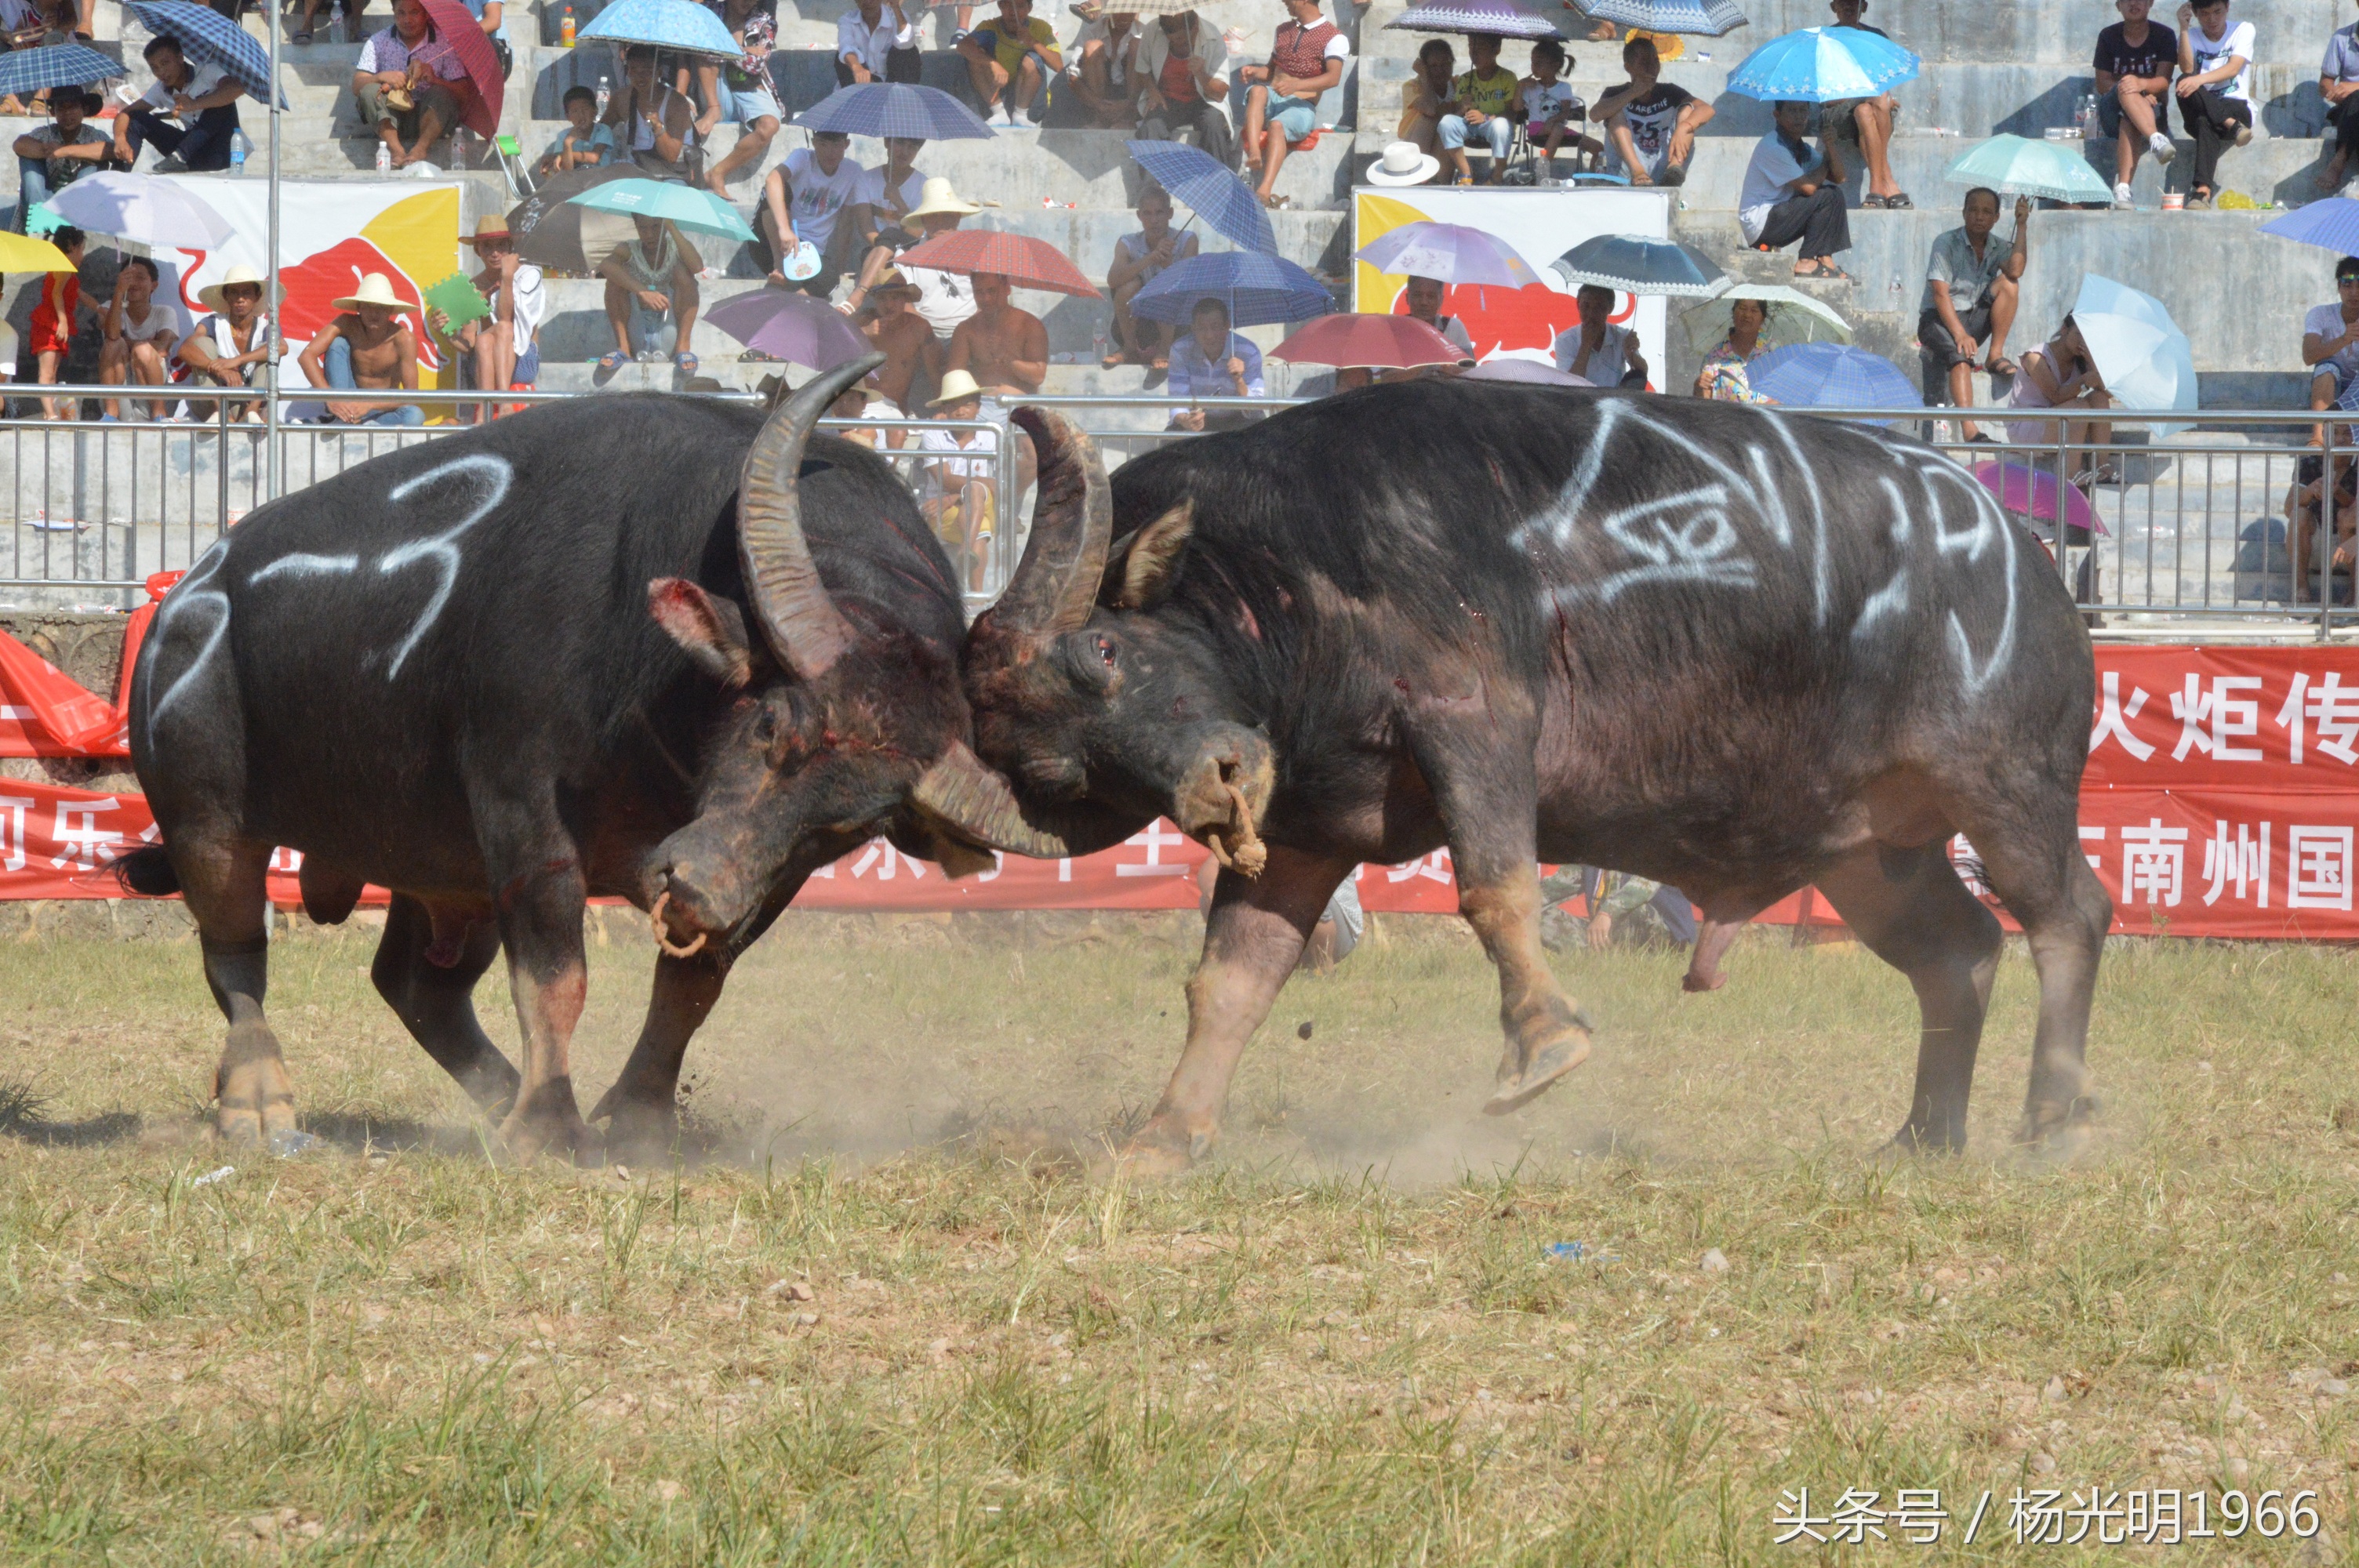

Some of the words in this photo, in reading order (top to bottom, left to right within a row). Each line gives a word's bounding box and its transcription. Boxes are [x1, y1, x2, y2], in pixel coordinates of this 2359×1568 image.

[2089, 671, 2359, 765] 火炬传
[2078, 818, 2354, 911] 南州国
